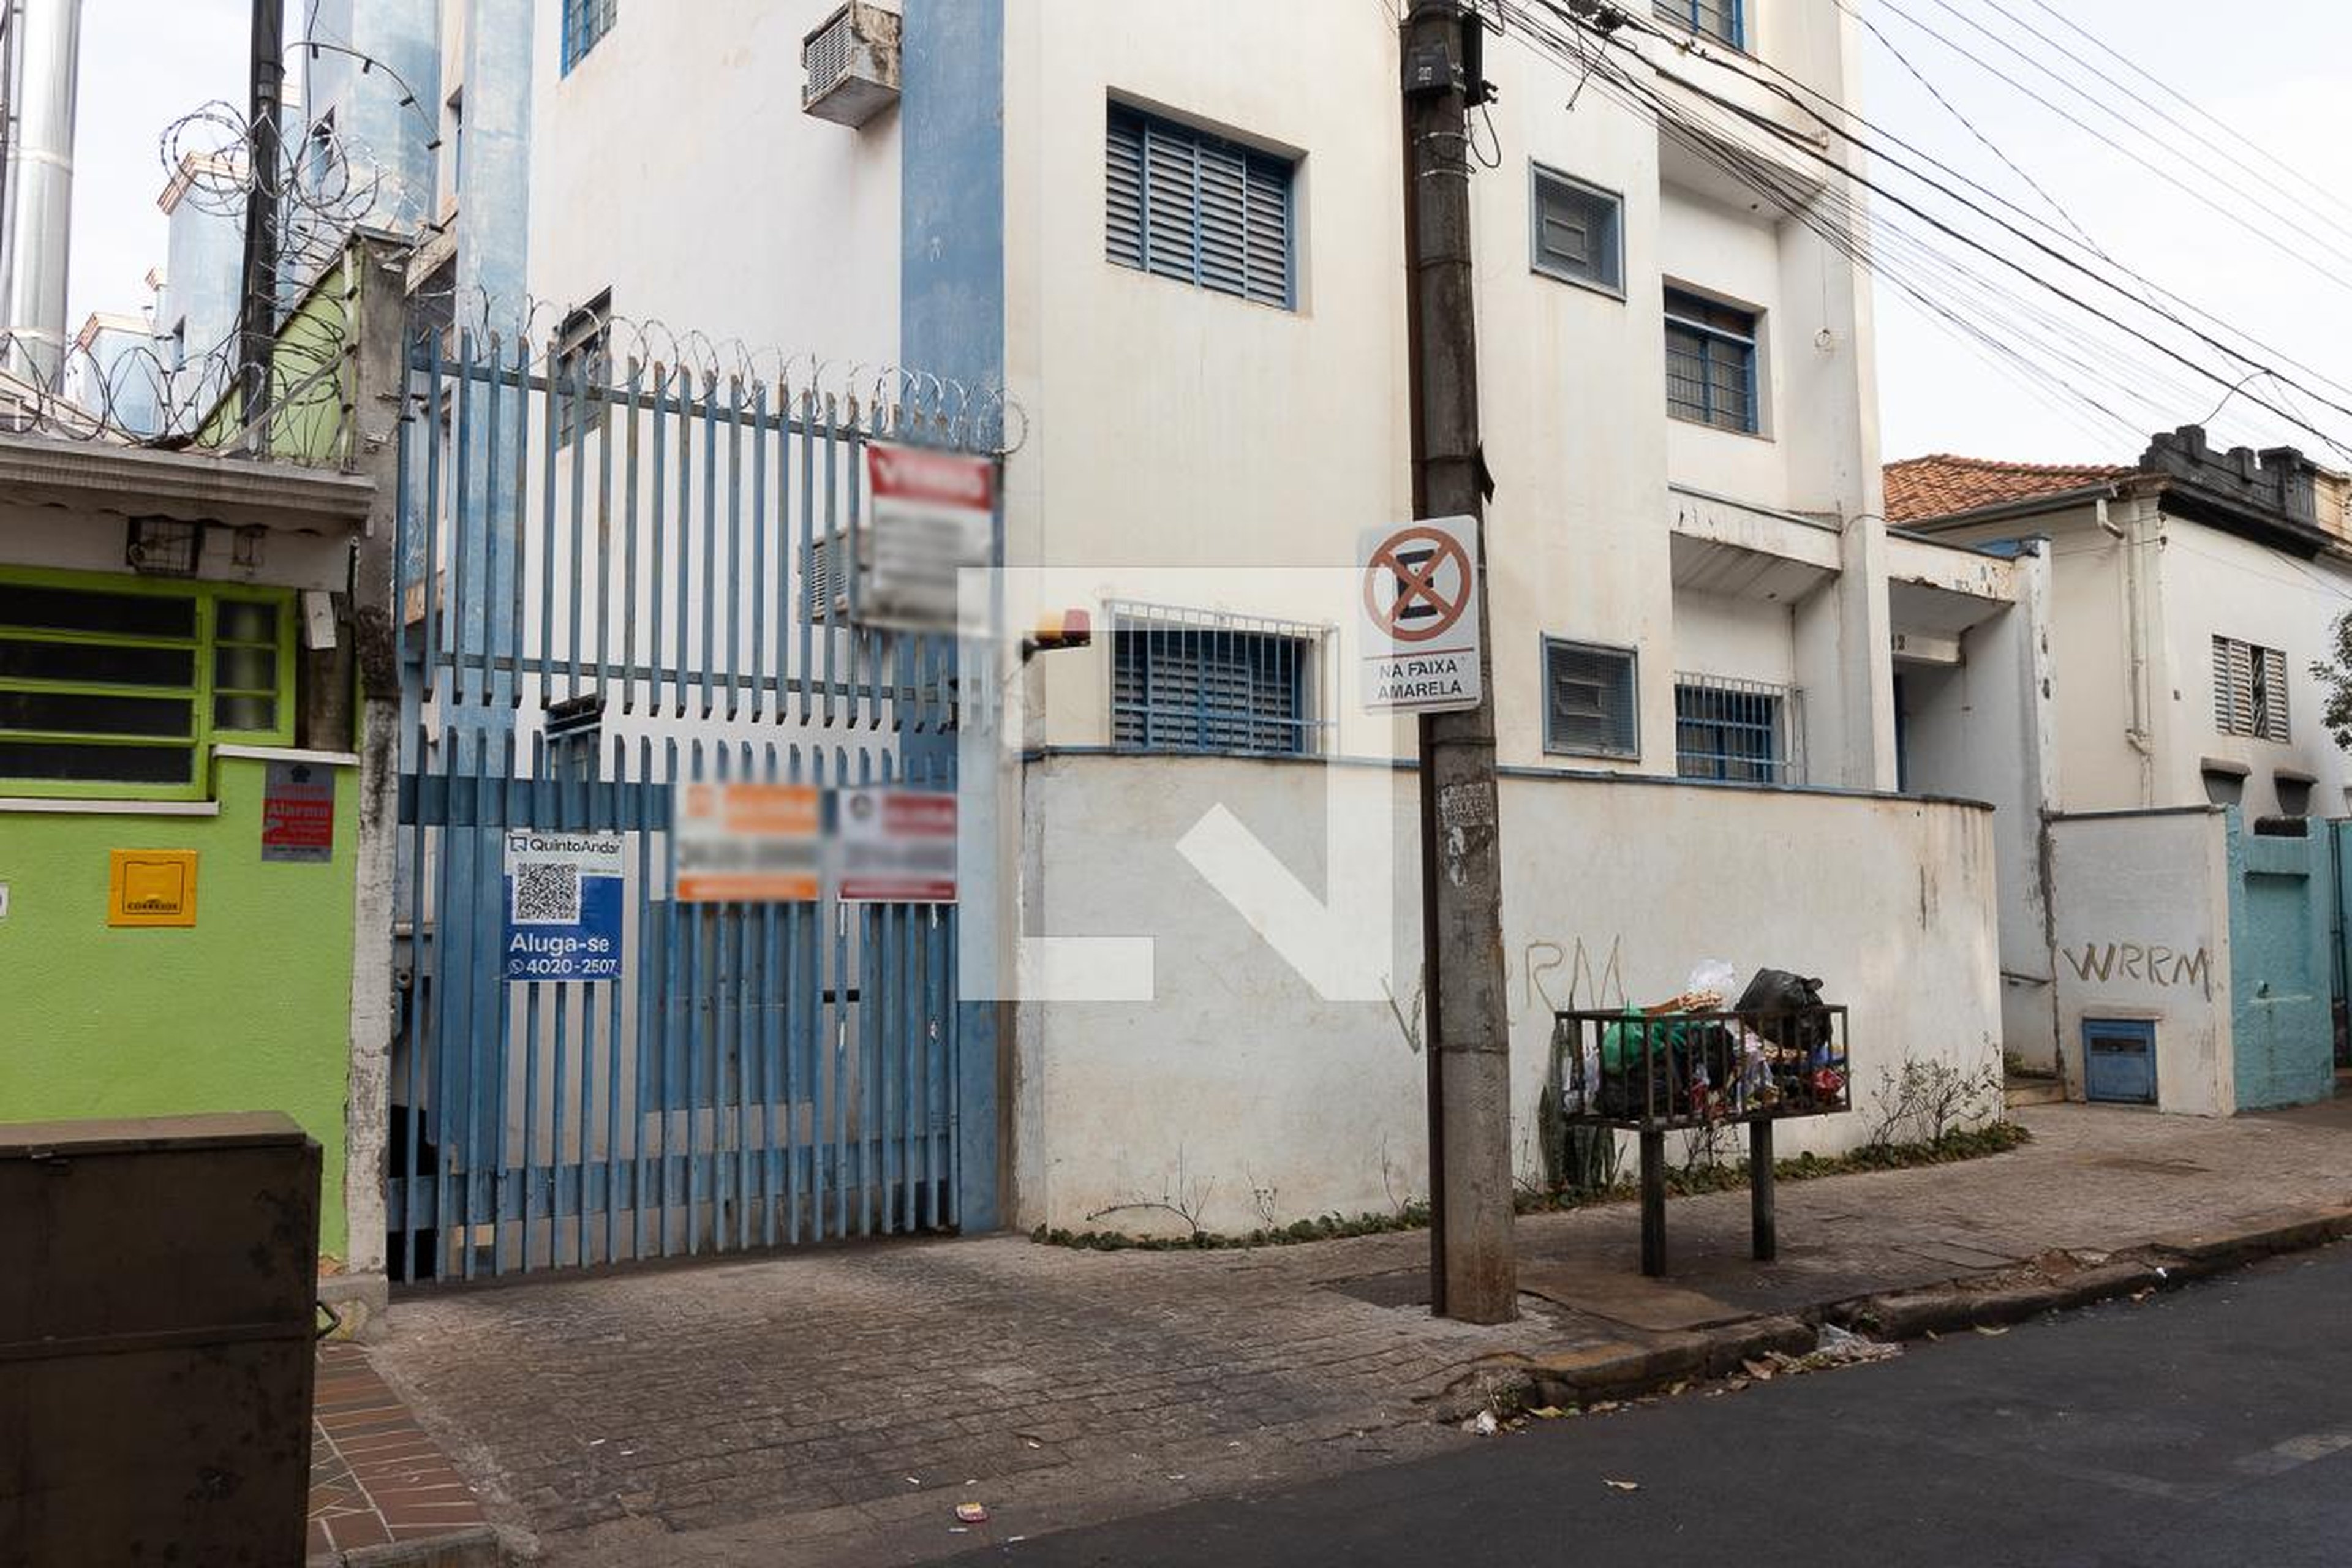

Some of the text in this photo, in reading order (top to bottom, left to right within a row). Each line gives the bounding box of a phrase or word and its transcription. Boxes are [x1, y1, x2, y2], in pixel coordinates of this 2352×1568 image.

[1379, 659, 1458, 679] NA FAIXA
[1378, 680, 1462, 699] AMARELA
[530, 838, 619, 854] QuintoAndar
[510, 932, 609, 957] Aluga-se
[526, 959, 617, 974] 4020-2507
